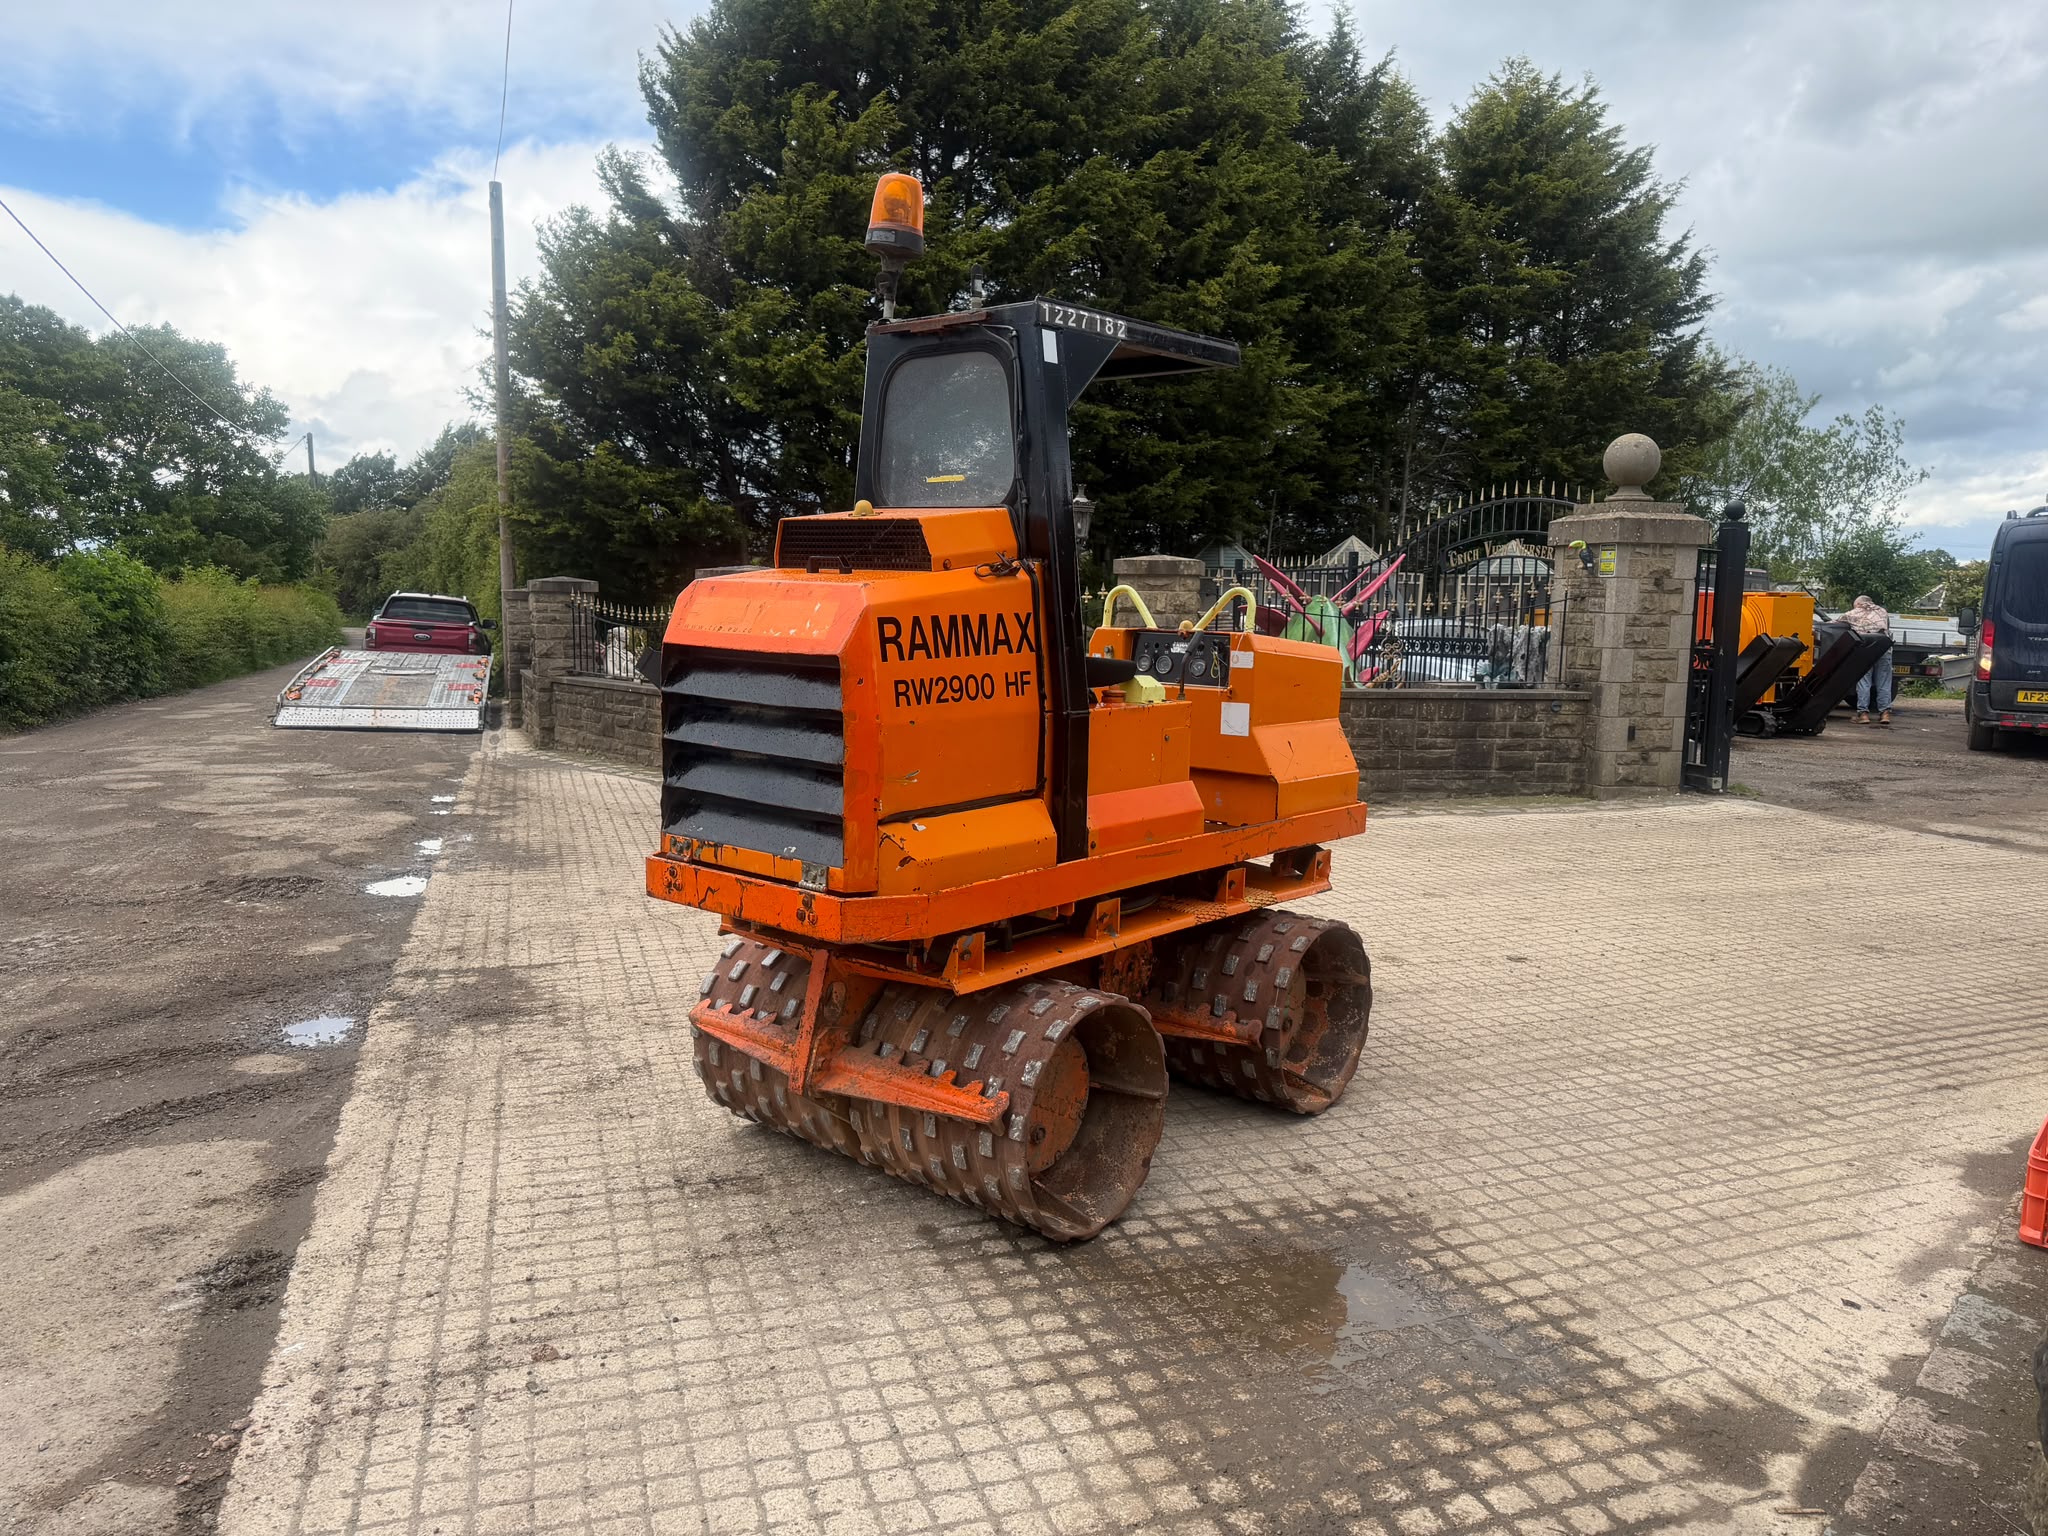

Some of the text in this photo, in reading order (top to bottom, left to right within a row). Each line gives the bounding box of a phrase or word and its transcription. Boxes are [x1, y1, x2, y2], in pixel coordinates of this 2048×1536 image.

[1042, 303, 1126, 338] 1227182
[877, 612, 1036, 662] RAMMAX
[894, 671, 1031, 707] RW2900 HF
